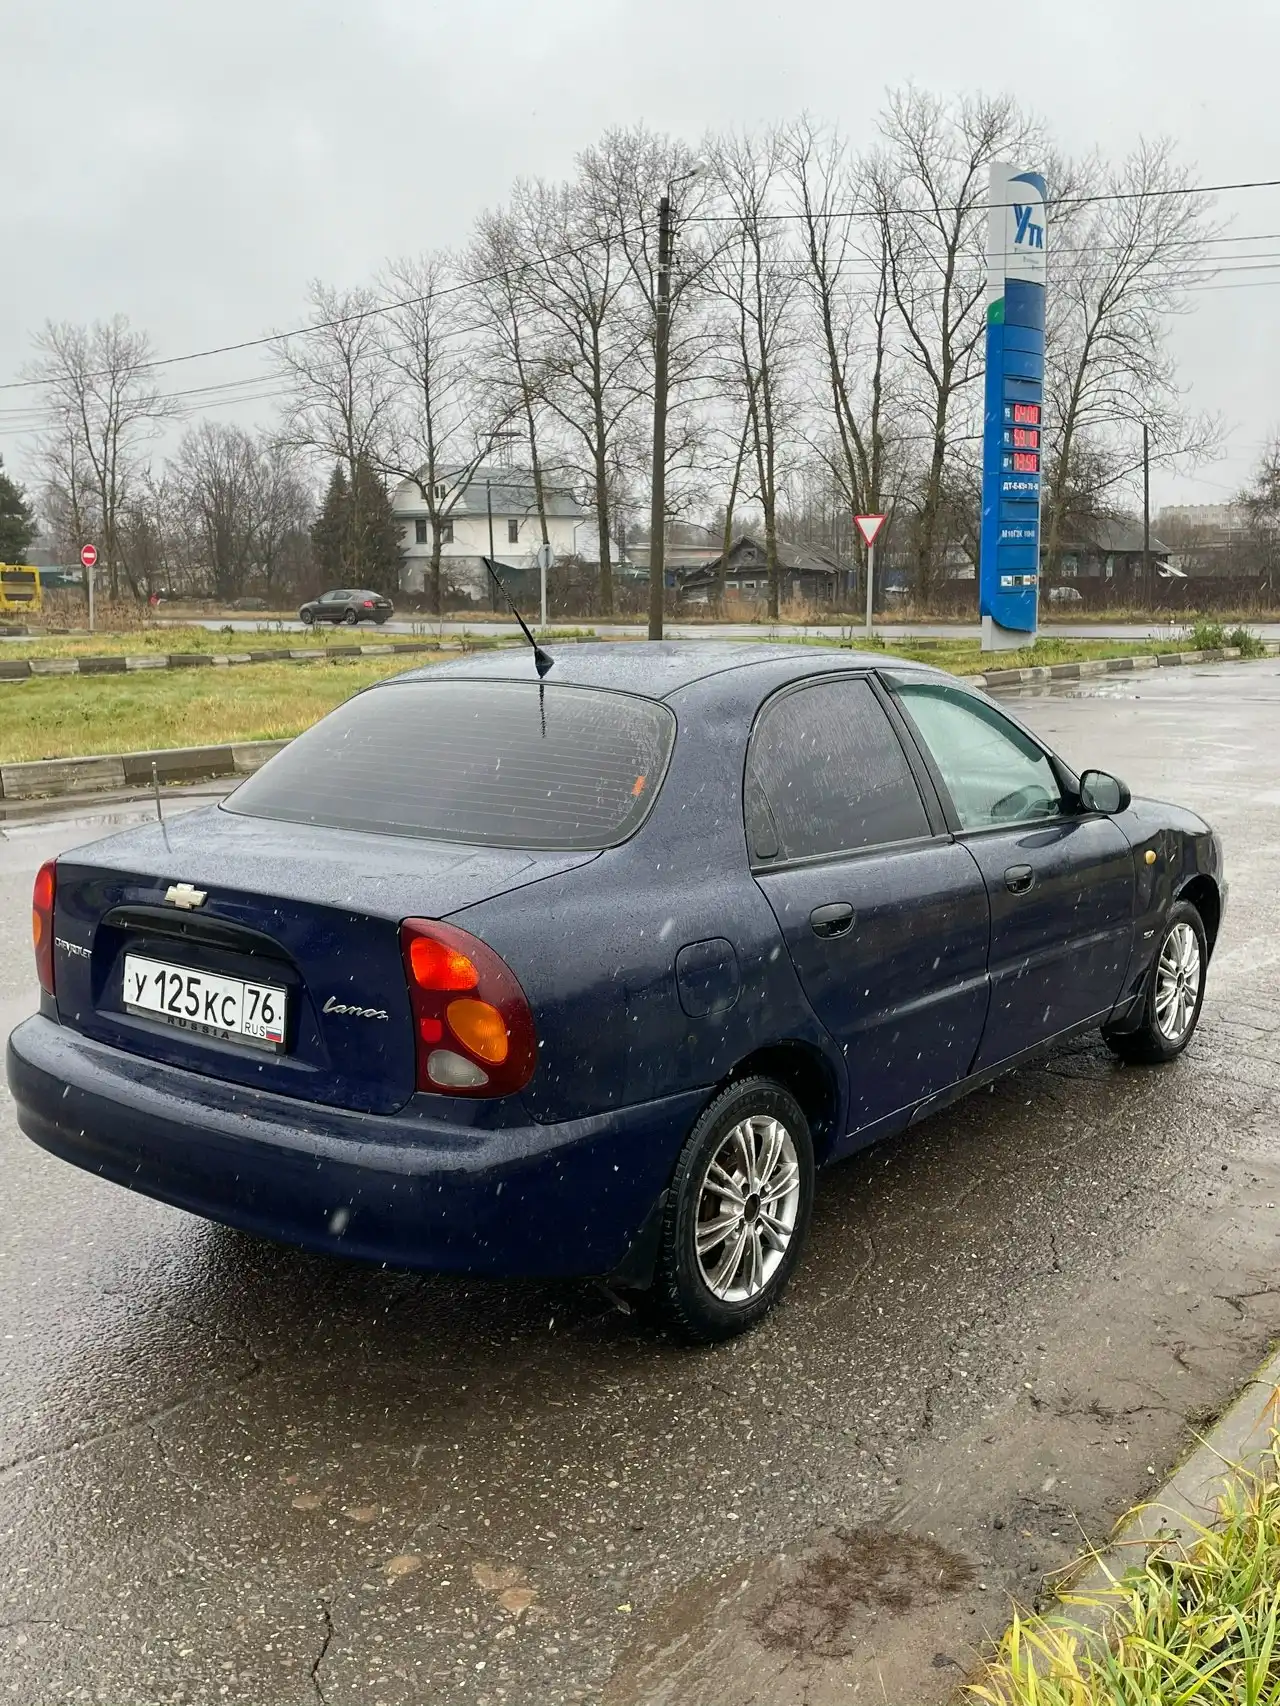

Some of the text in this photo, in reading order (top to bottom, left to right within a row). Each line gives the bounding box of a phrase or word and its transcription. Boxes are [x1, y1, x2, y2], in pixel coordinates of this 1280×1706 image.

[55, 936, 92, 960] CHEVROLET
[247, 988, 275, 1025] 76
[322, 995, 389, 1021] Lanos
[167, 1015, 231, 1040] RUSSIA
[244, 1022, 266, 1037] RUS
